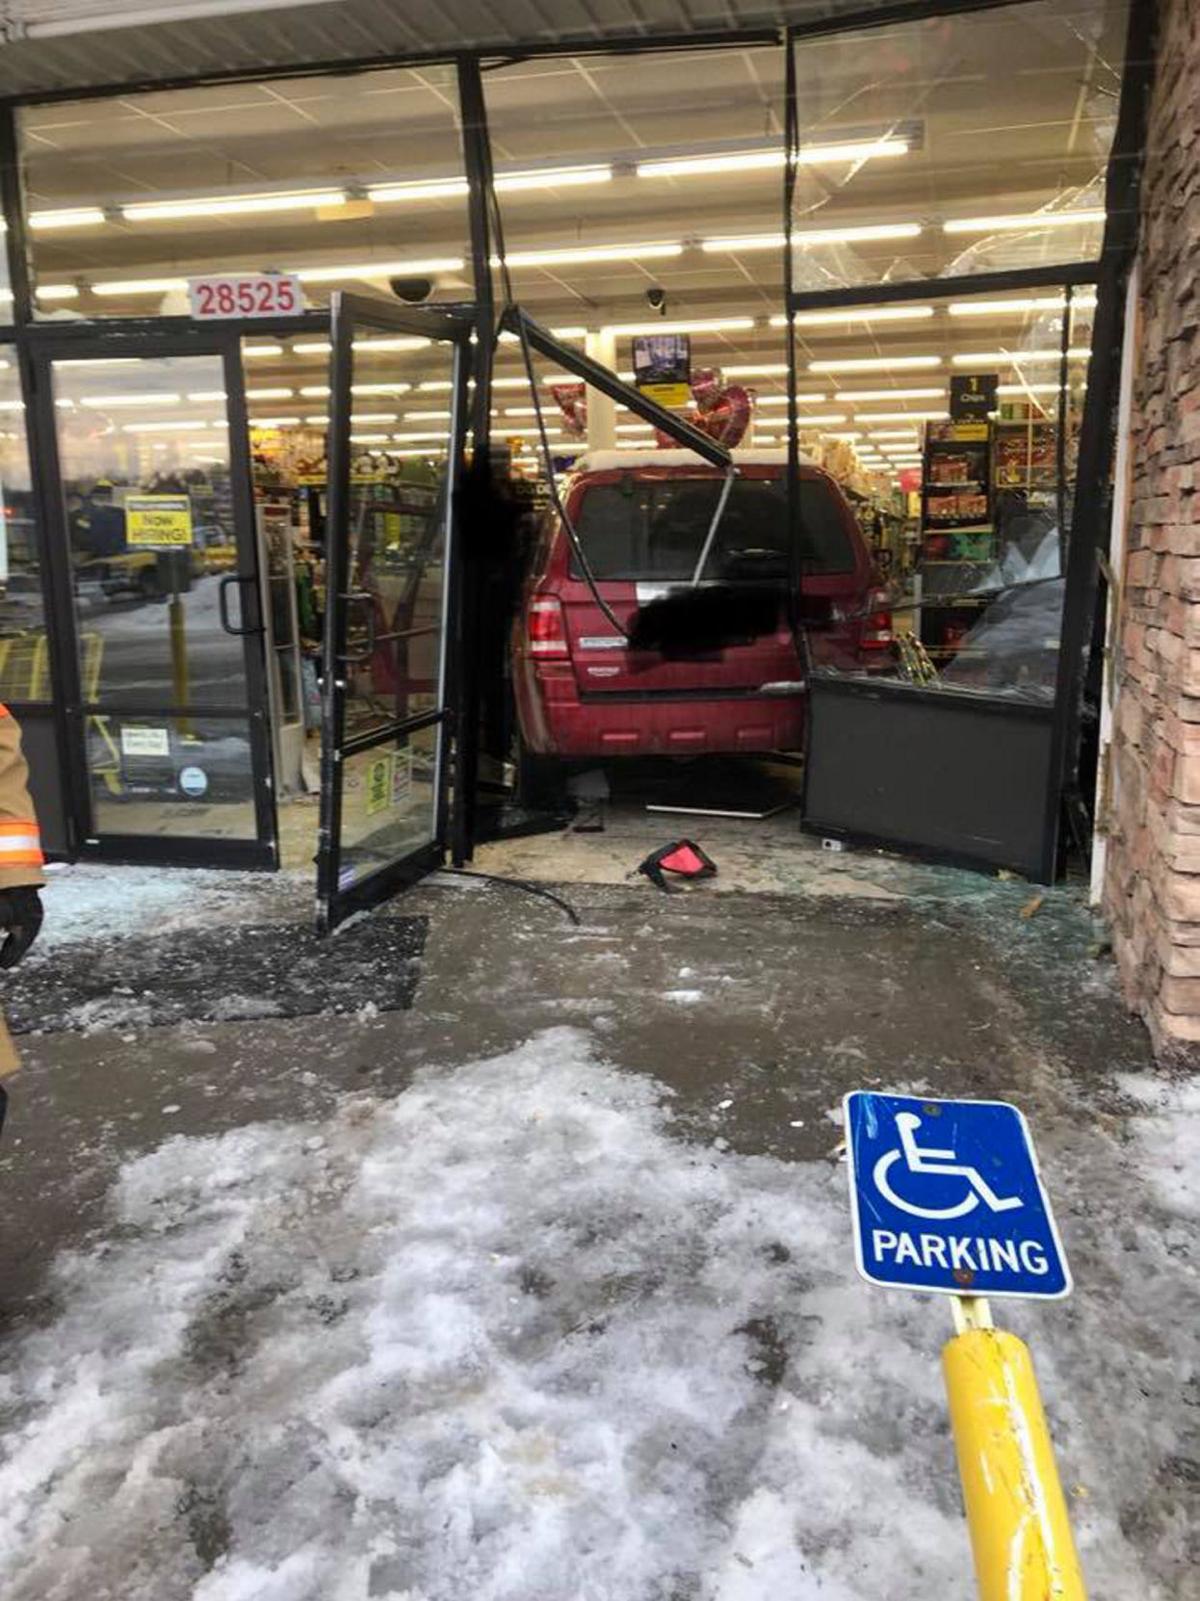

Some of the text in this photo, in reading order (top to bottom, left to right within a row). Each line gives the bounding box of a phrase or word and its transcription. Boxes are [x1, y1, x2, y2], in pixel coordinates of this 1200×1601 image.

[197, 281, 294, 314] 28525
[143, 514, 174, 528] NOW
[131, 528, 187, 542] HIRING!
[872, 1229, 1049, 1275] PARKING
